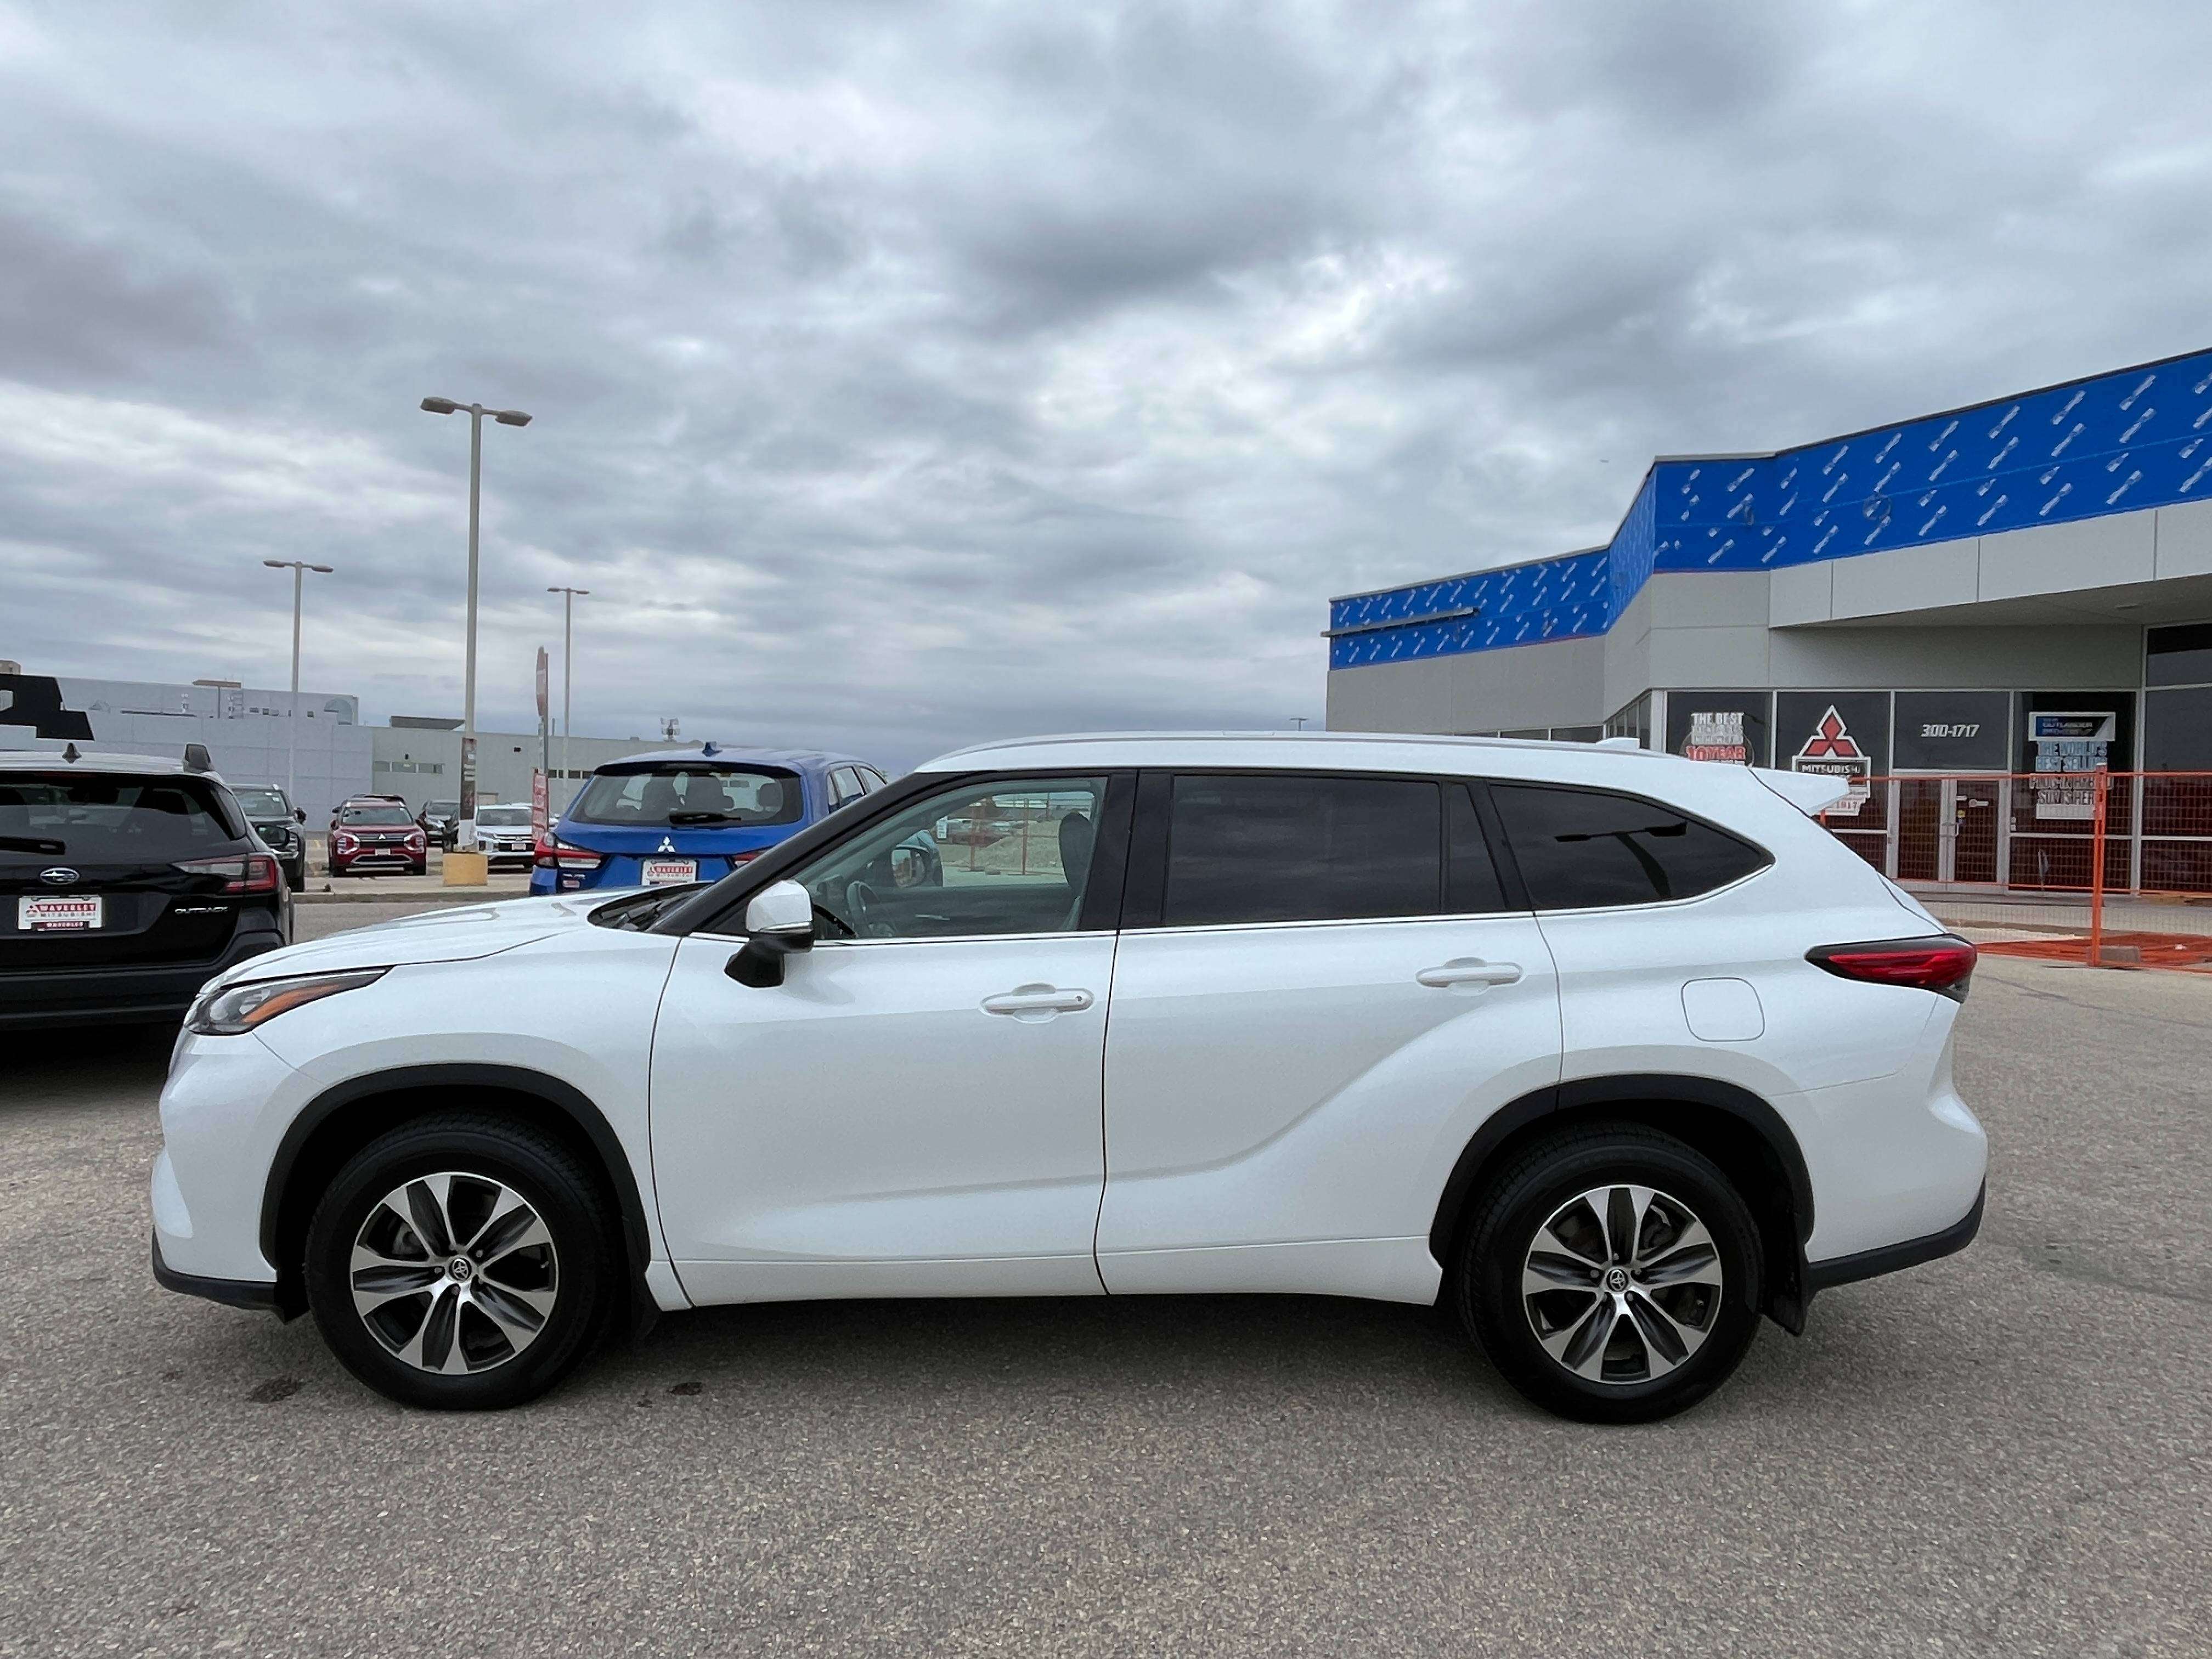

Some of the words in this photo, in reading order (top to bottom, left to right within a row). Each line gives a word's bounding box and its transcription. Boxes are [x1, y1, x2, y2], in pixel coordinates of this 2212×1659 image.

[1691, 712, 1713, 724] THE
[1716, 712, 1745, 724] BEST
[1920, 724, 1979, 737] 300-1717
